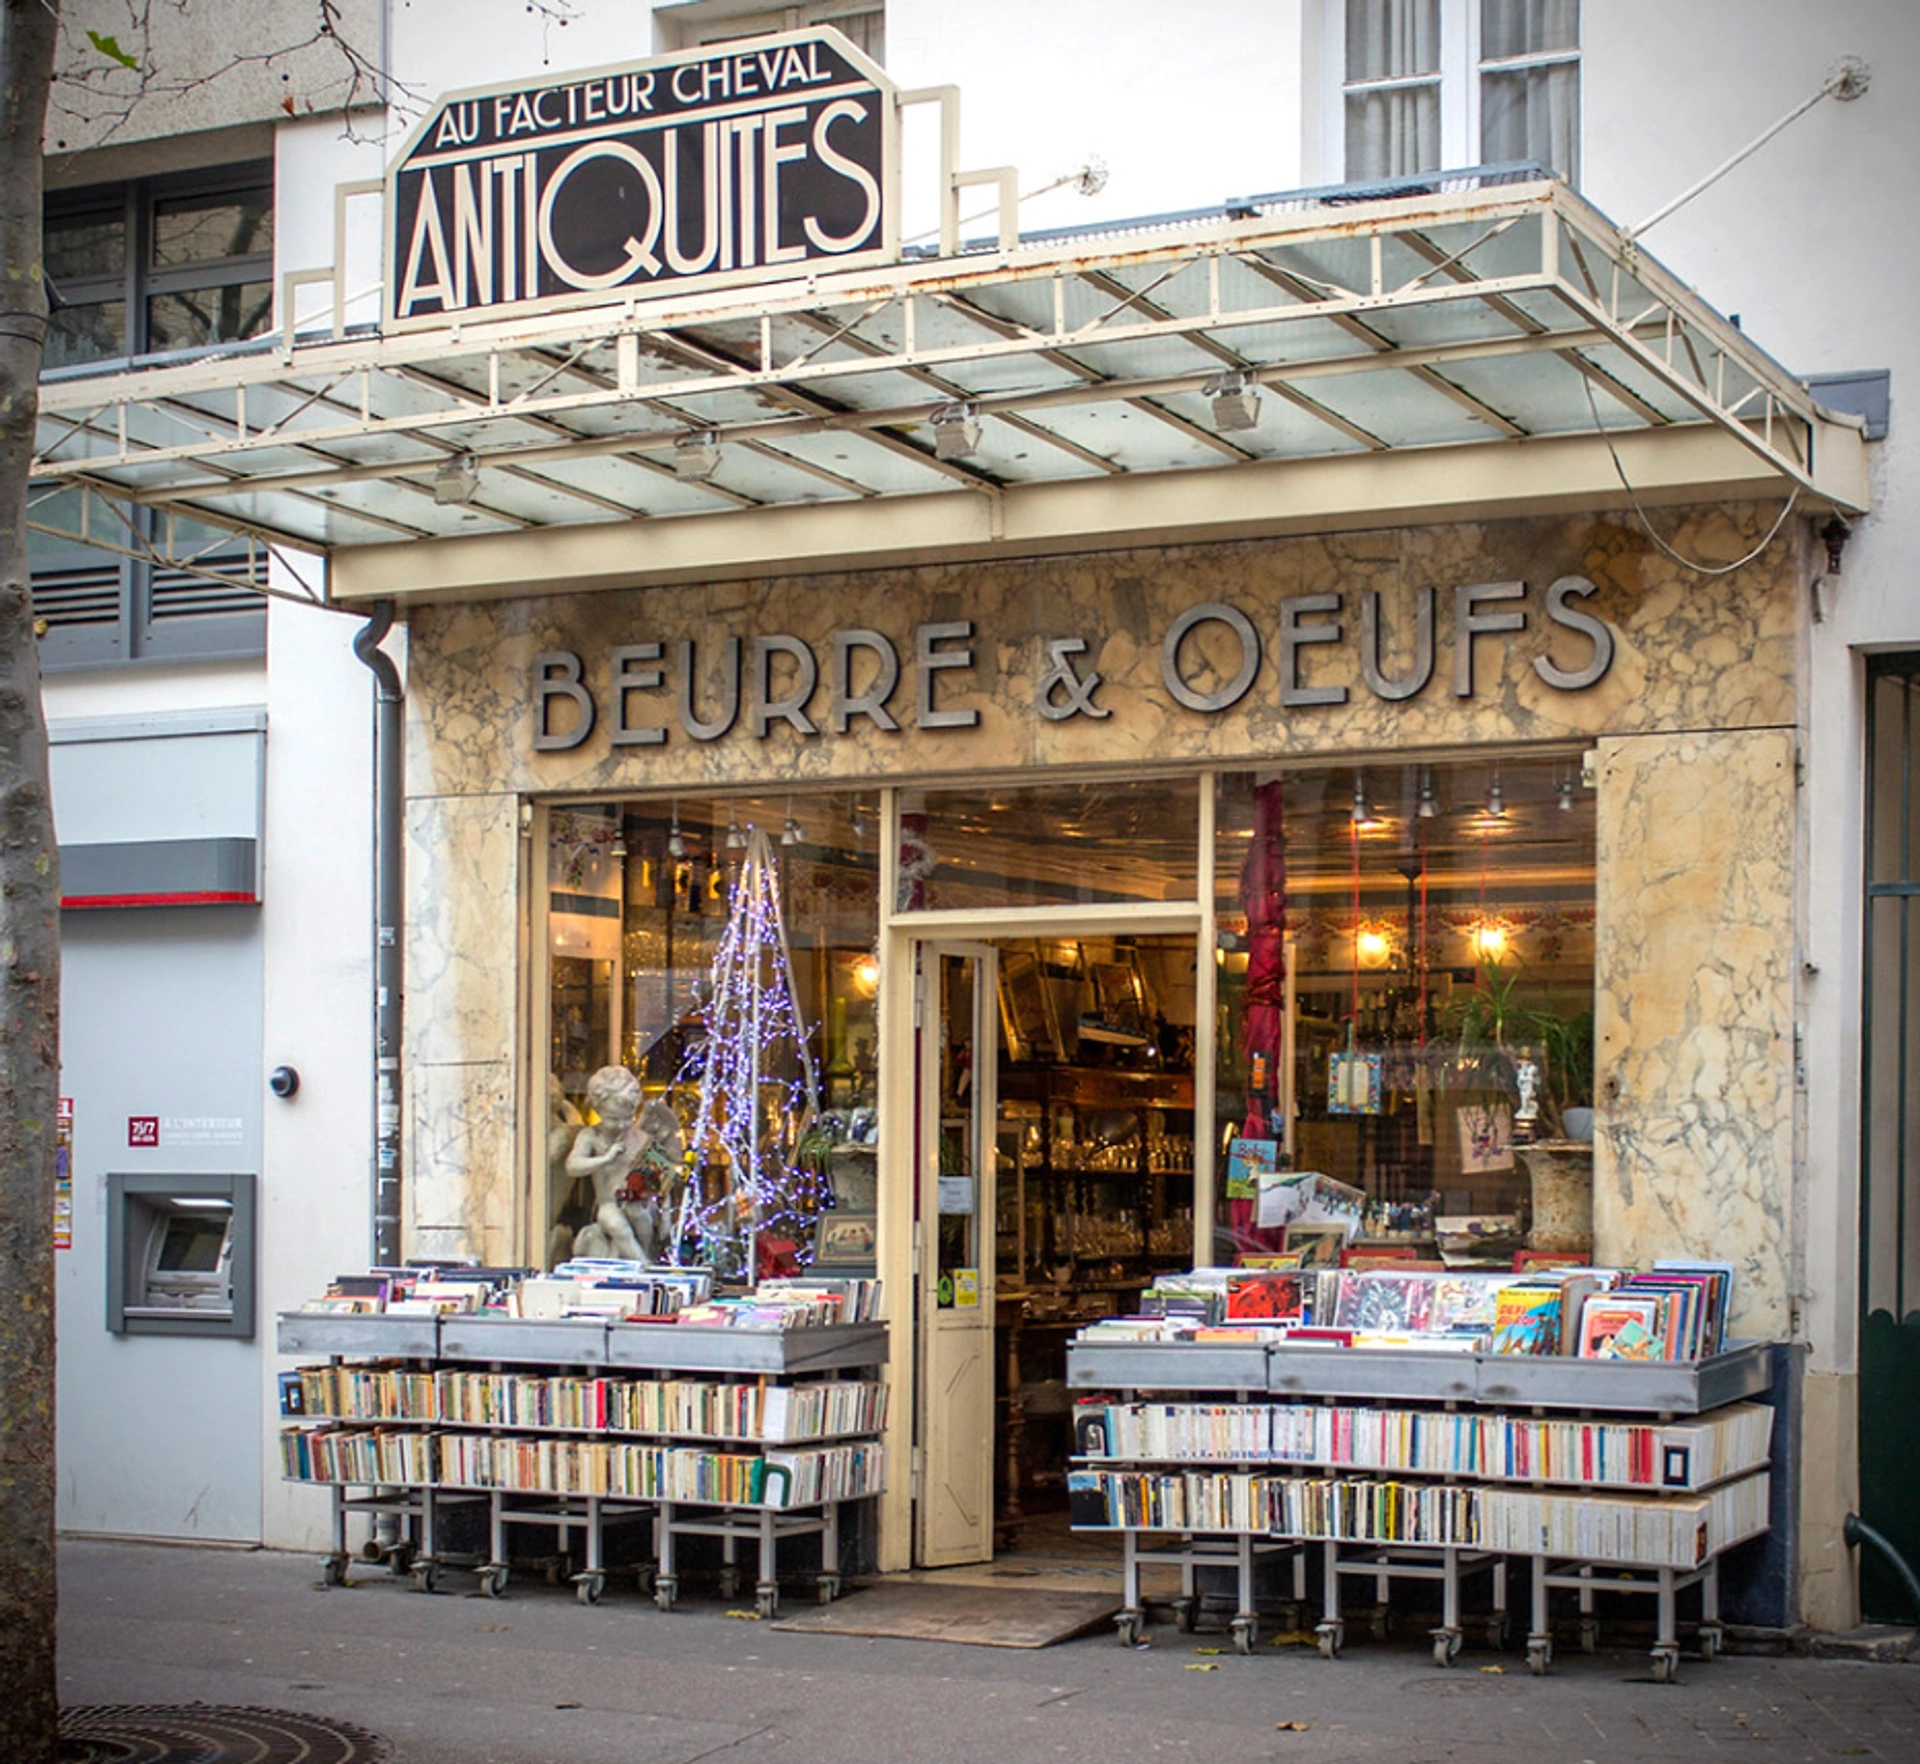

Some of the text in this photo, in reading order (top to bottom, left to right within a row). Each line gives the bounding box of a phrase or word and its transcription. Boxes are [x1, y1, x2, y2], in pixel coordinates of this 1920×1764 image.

[435, 44, 832, 149] AU FACTEUR CHEVAL
[397, 99, 882, 319] ANTIQUITES
[532, 574, 1615, 751] BEURRE & OEUFS
